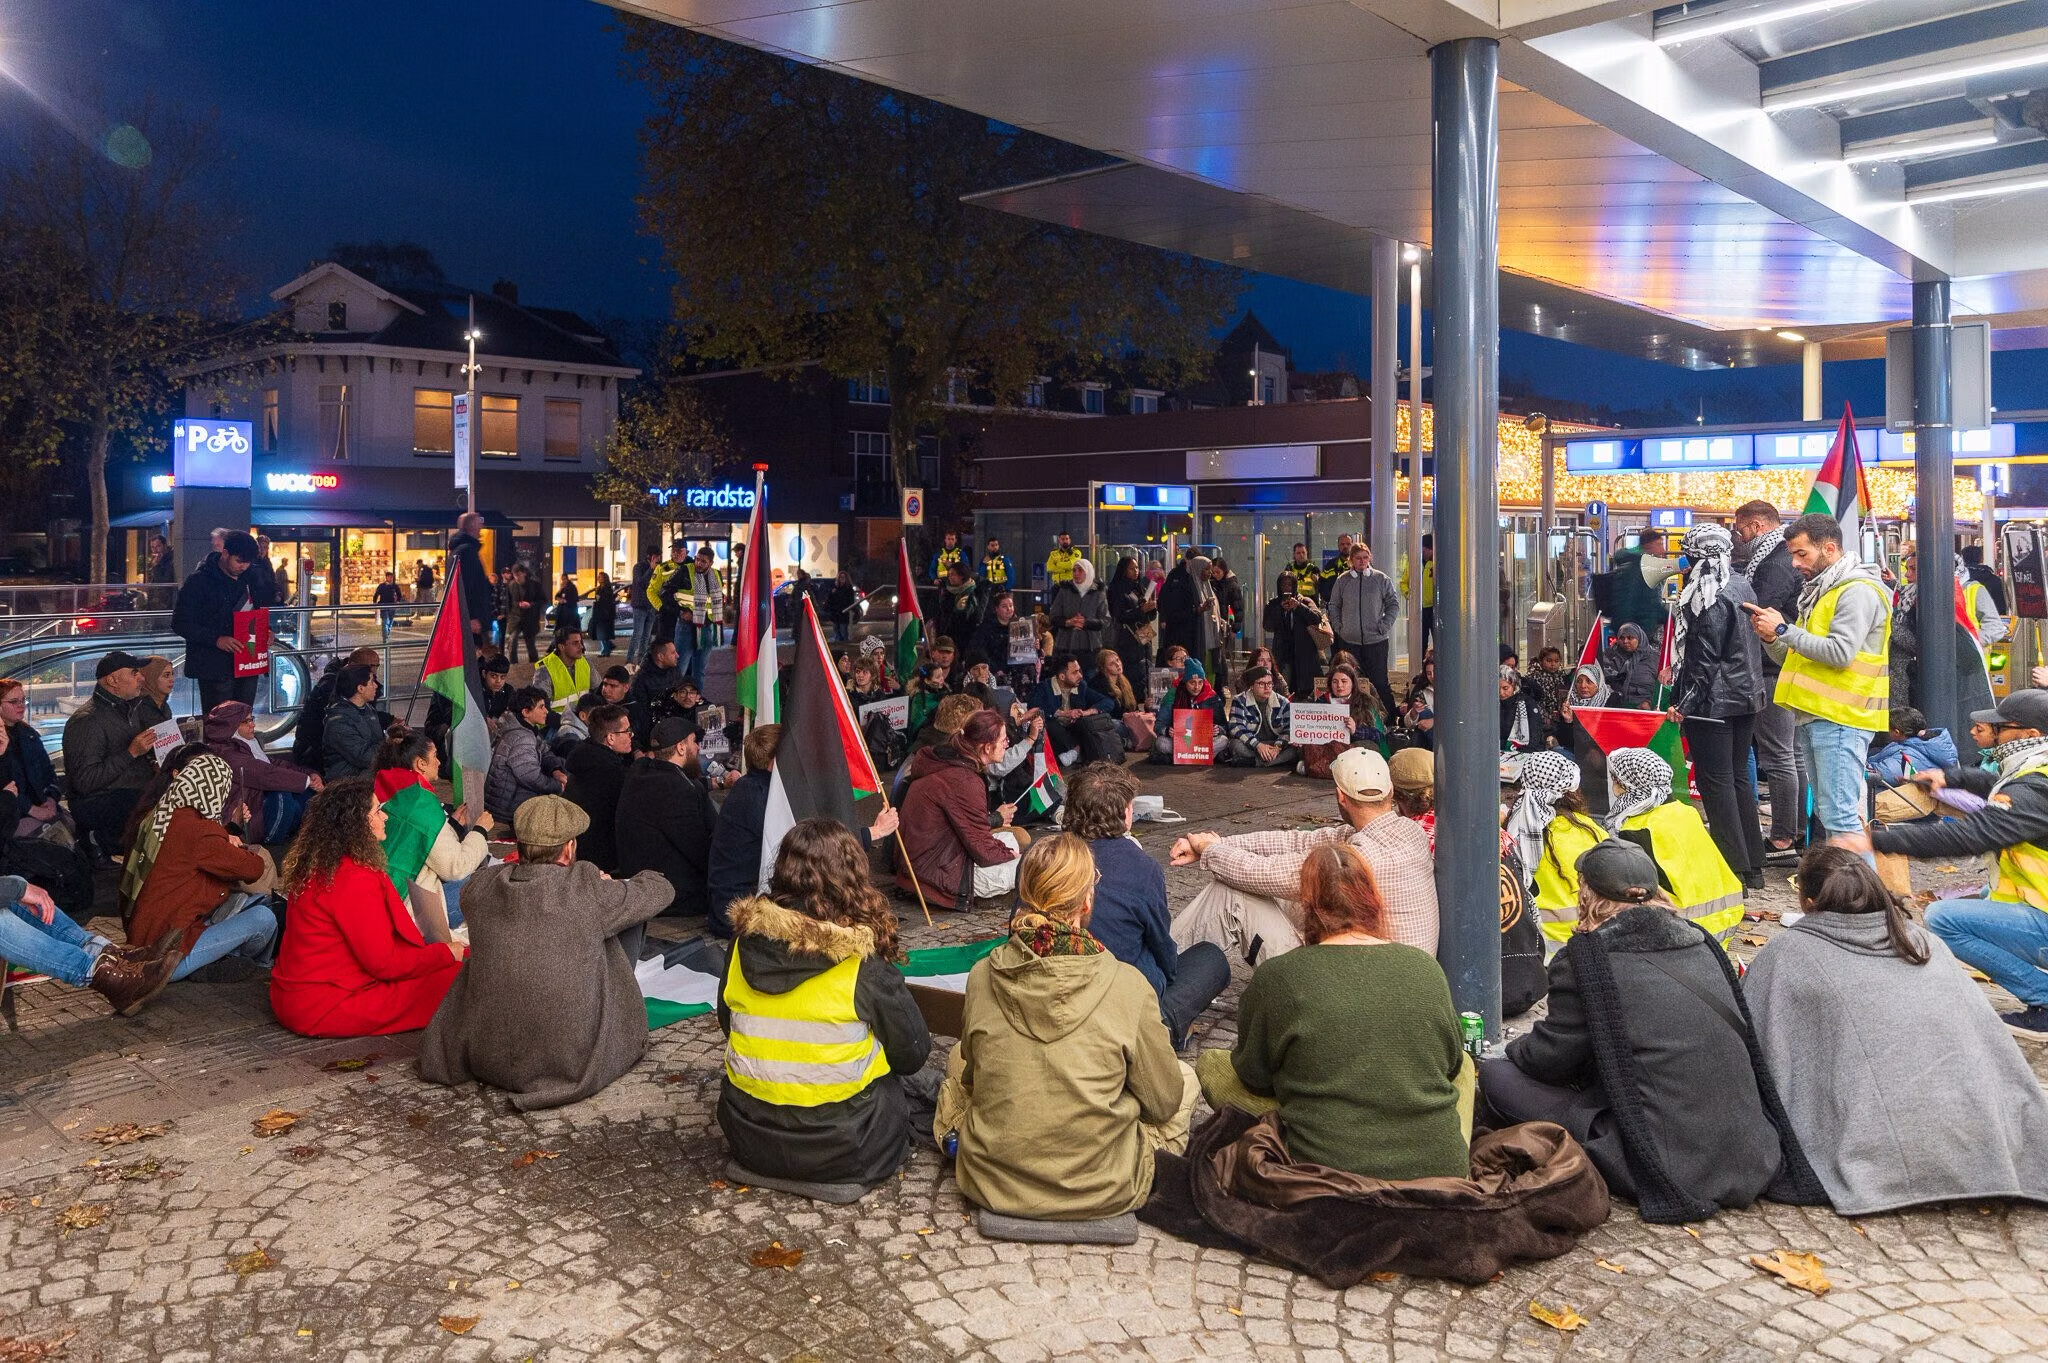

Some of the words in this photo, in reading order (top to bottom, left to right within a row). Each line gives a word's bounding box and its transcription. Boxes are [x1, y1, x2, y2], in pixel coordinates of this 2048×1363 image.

[188, 425, 208, 452] P
[267, 473, 316, 492] WOK
[1294, 713, 1345, 722] occupation
[1294, 729, 1346, 740] Genocide
[1177, 752, 1210, 760] Palestine
